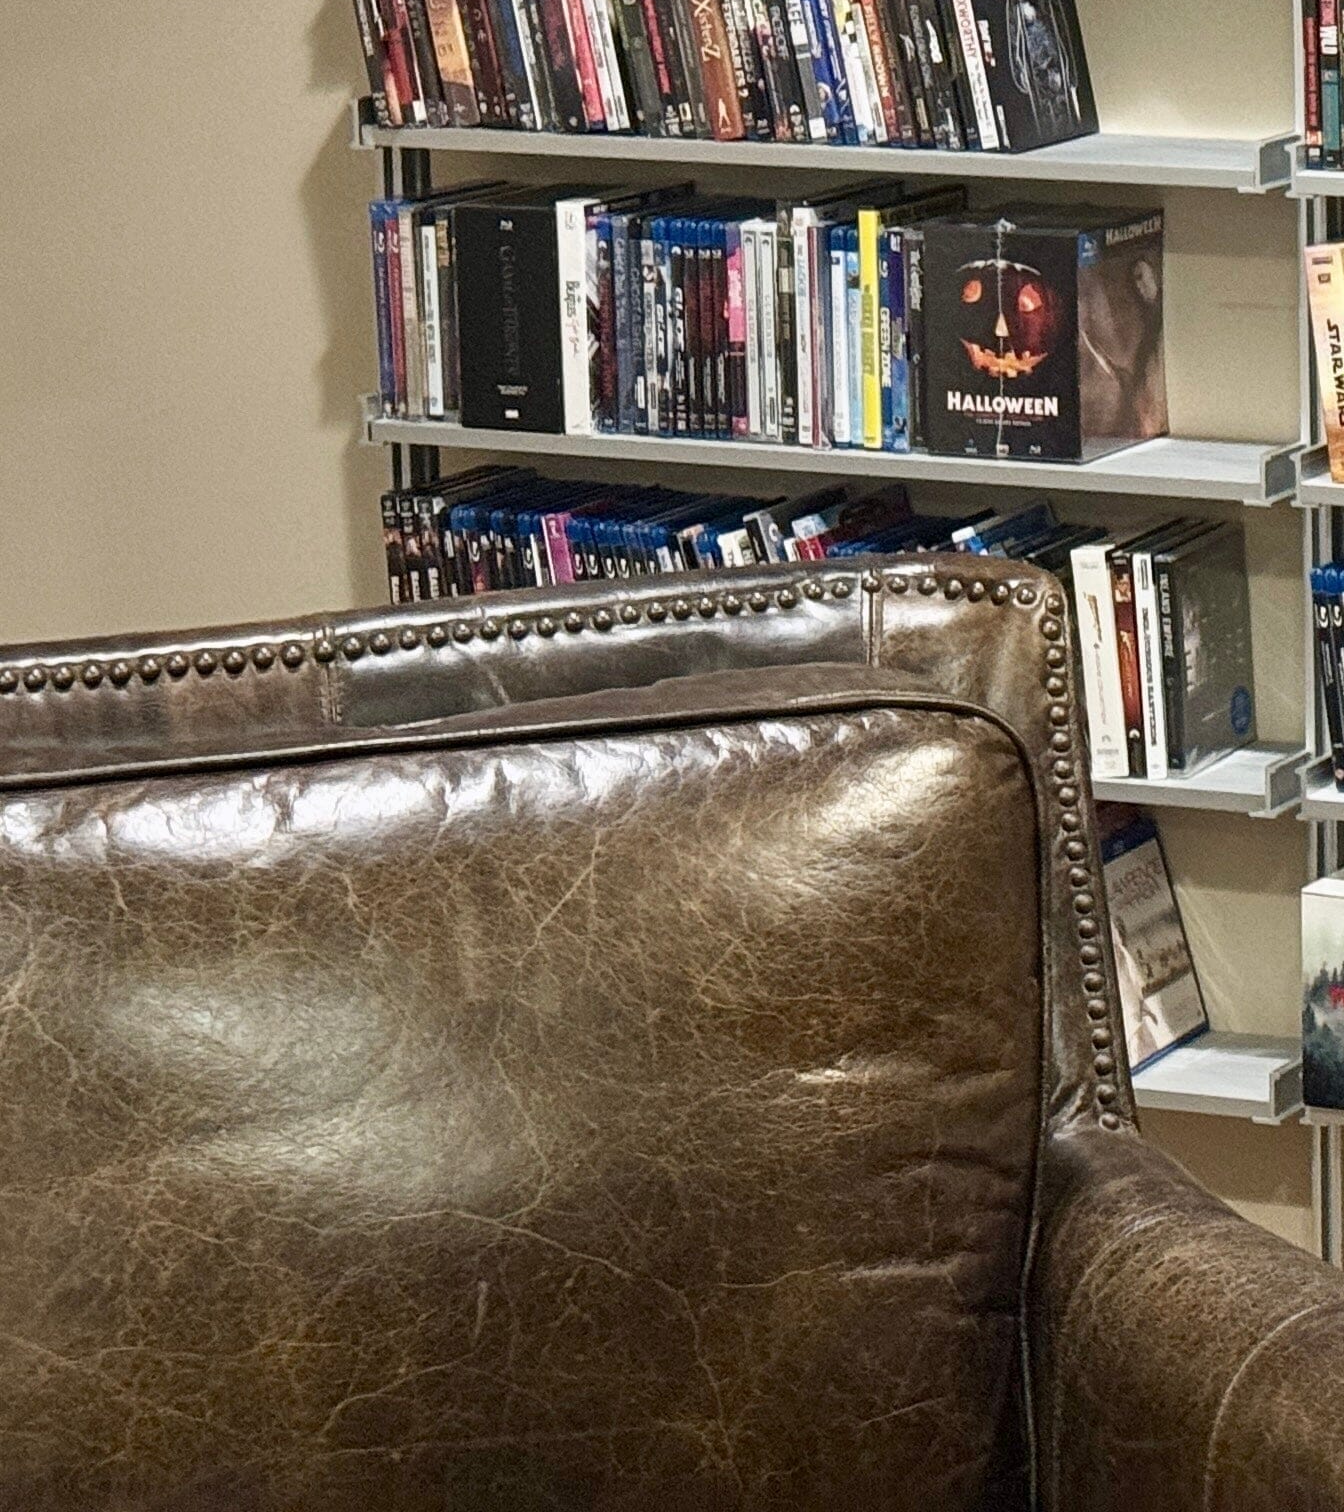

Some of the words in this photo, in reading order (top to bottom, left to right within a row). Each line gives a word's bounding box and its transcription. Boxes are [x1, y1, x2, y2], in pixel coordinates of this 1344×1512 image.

[1105, 216, 1162, 245] HALLOWEEN
[880, 307, 891, 350] GREEN
[1327, 319, 1342, 368] STAR
[882, 352, 892, 387] ZONE
[947, 391, 1058, 417] HALLOWEEN
[1160, 573, 1172, 614] INLAND
[1162, 617, 1176, 658] EMPIRE
